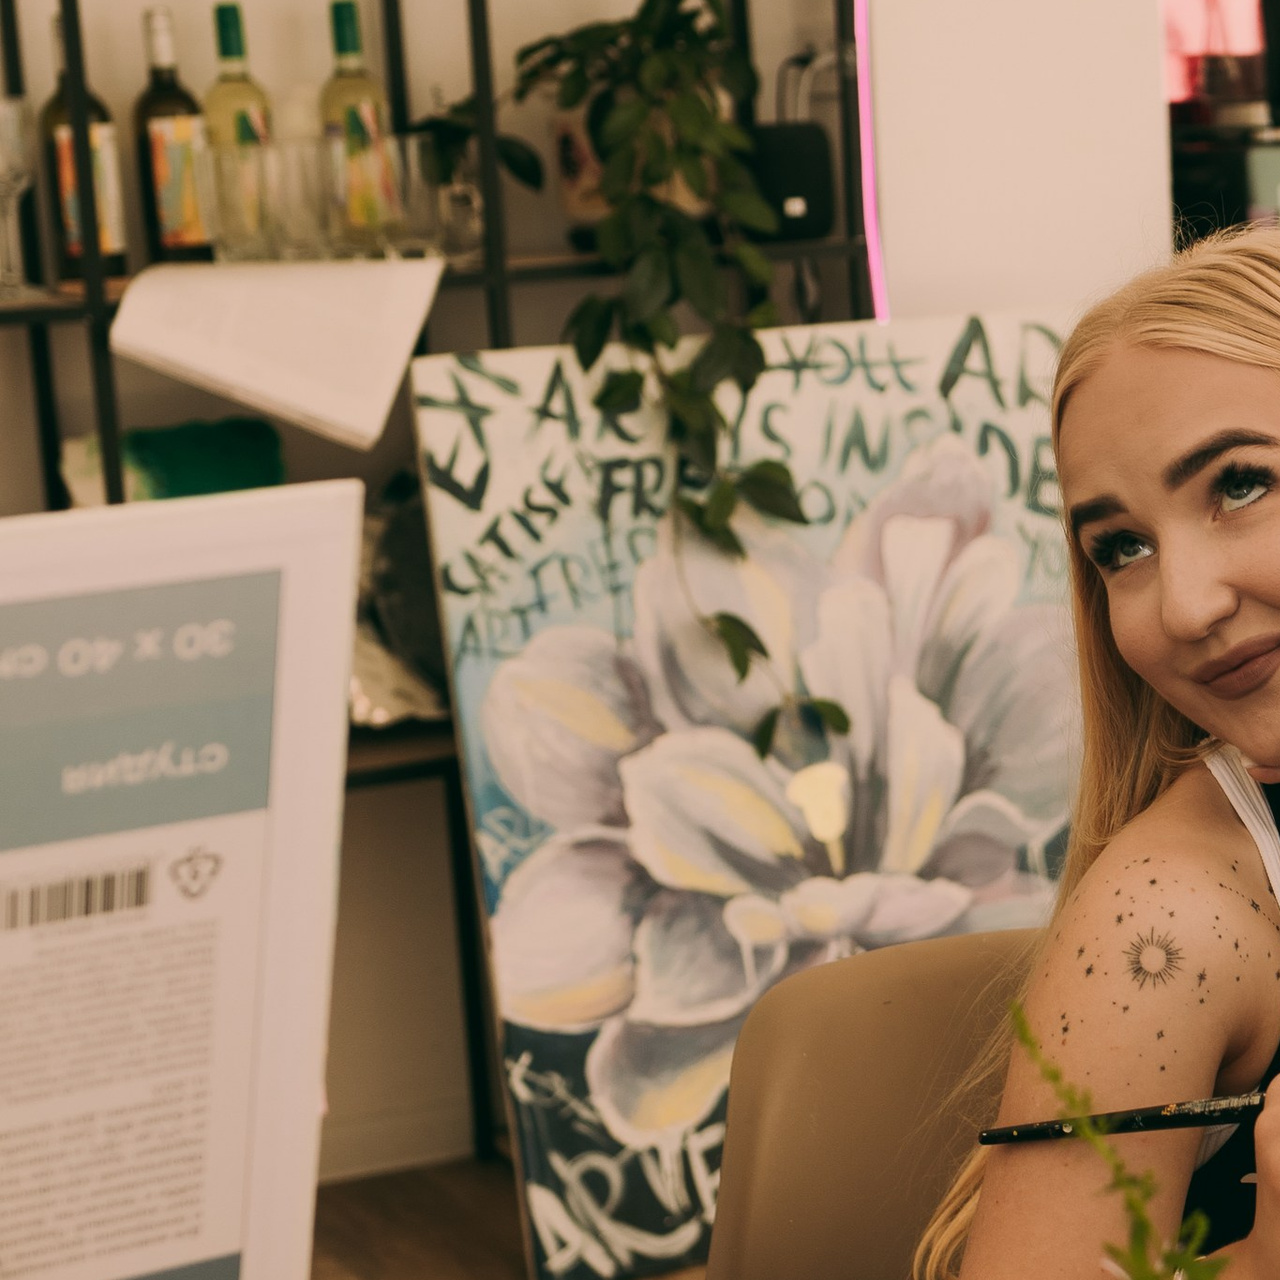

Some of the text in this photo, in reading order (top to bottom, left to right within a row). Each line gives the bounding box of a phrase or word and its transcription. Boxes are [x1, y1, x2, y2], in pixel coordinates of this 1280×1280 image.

[57, 638, 122, 678] 40
[172, 618, 236, 662] 30
[61, 740, 229, 795] студия
